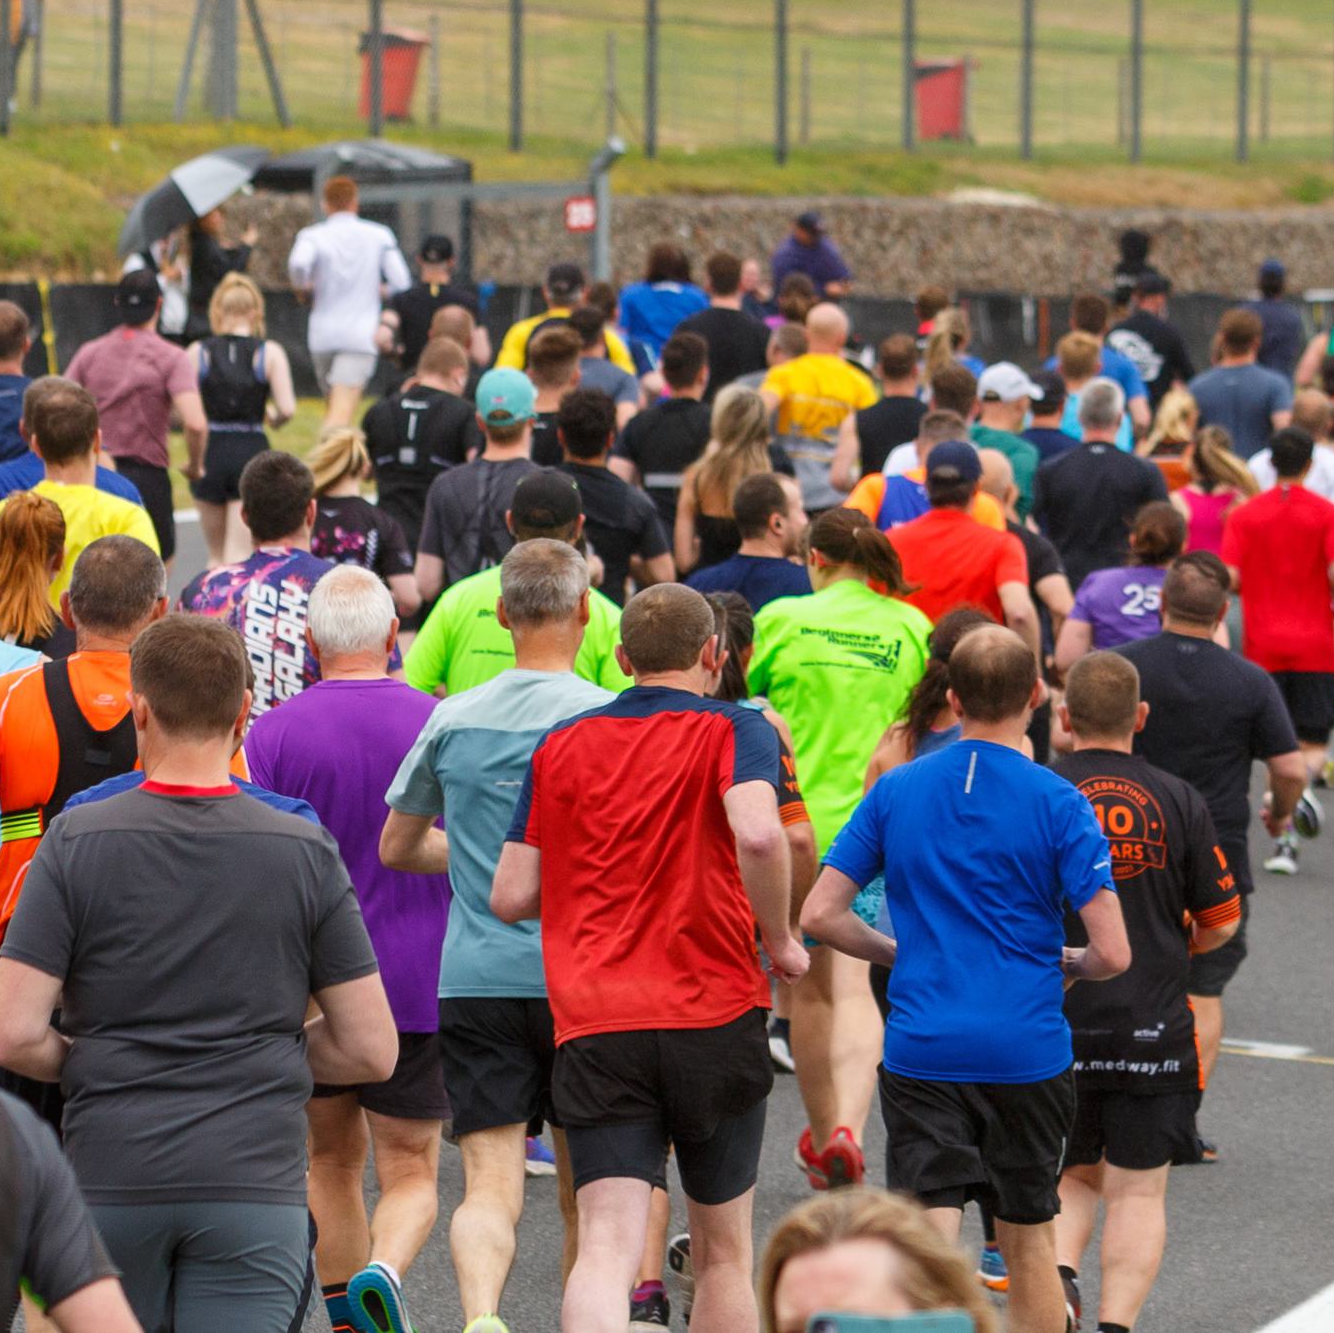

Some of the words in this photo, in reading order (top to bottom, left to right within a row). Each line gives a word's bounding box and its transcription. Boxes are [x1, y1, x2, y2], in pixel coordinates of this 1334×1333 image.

[1120, 583, 1162, 616] 25
[243, 578, 279, 730] ARDIANS
[1081, 781, 1149, 807] ELEBRATING
[1094, 804, 1134, 835] 10
[1110, 843, 1144, 860] ARS
[1072, 1059, 1180, 1076] w.medway.fit
